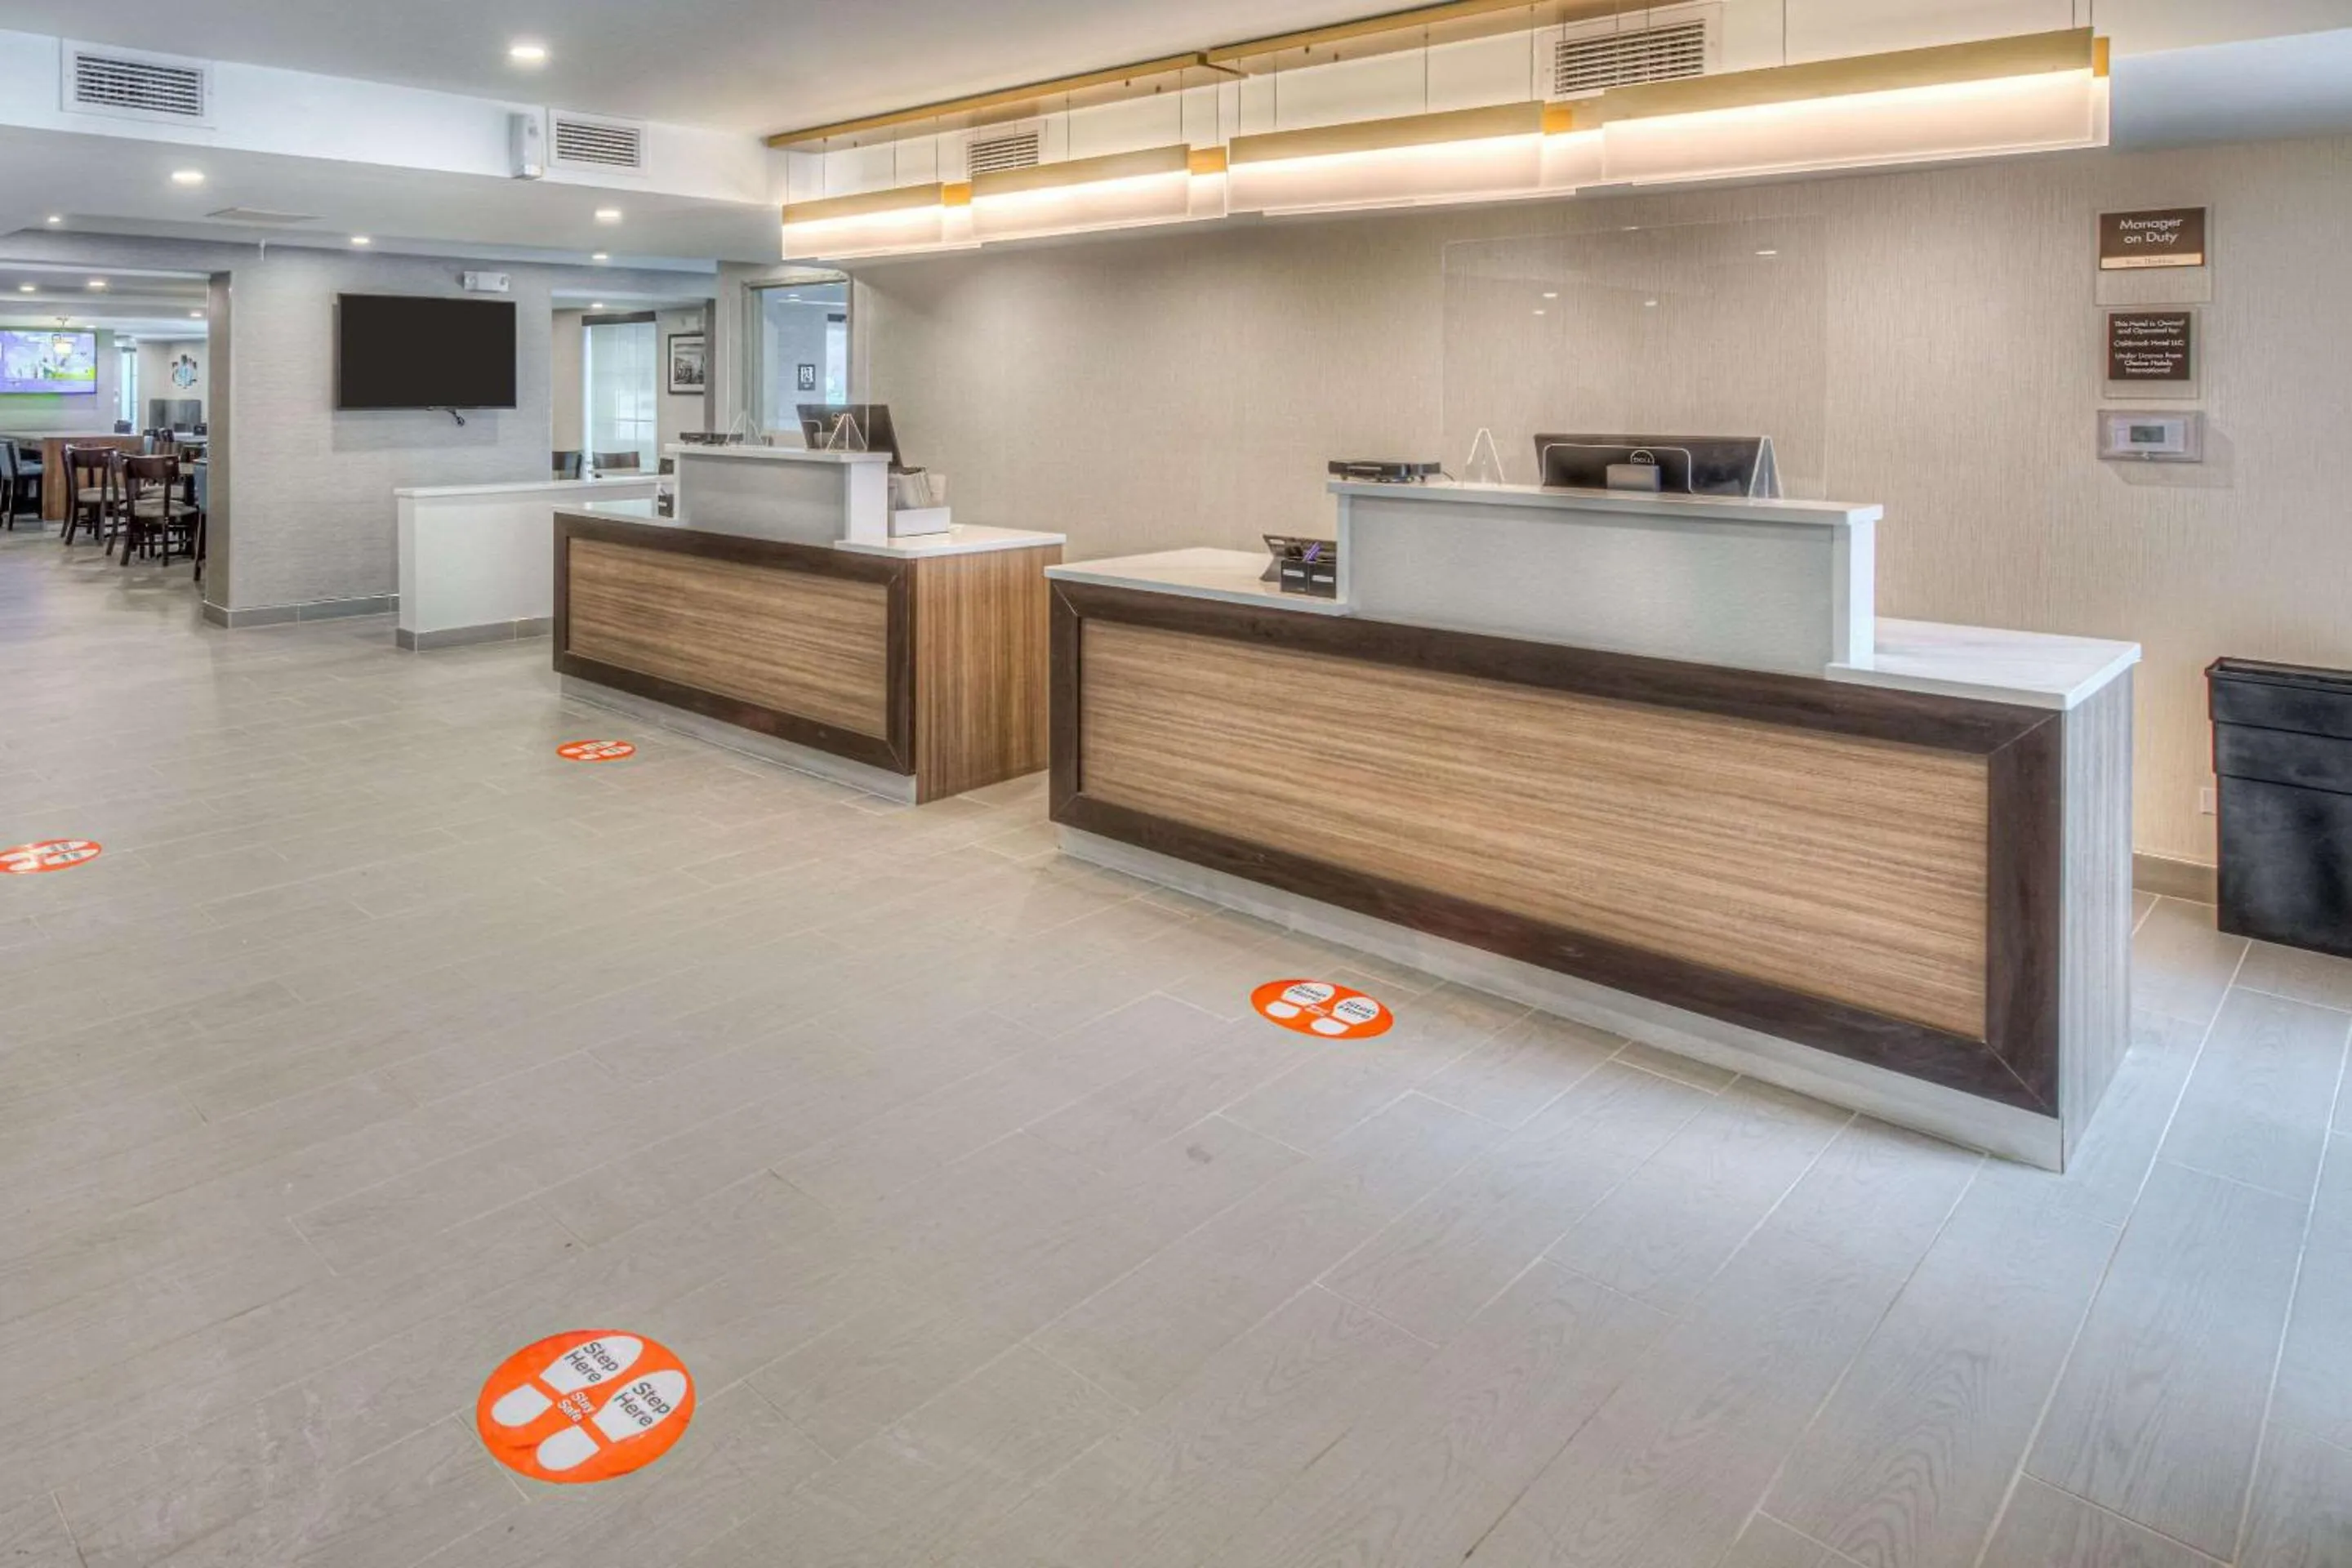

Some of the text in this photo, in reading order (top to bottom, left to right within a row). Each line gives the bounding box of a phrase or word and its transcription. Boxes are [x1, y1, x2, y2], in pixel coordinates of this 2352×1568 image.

[2119, 218, 2184, 230] Manager
[2124, 231, 2179, 244] on Duty
[564, 1350, 602, 1383] Here
[583, 1342, 619, 1373] Step
[614, 1392, 653, 1427] Here
[632, 1382, 670, 1414] Step
